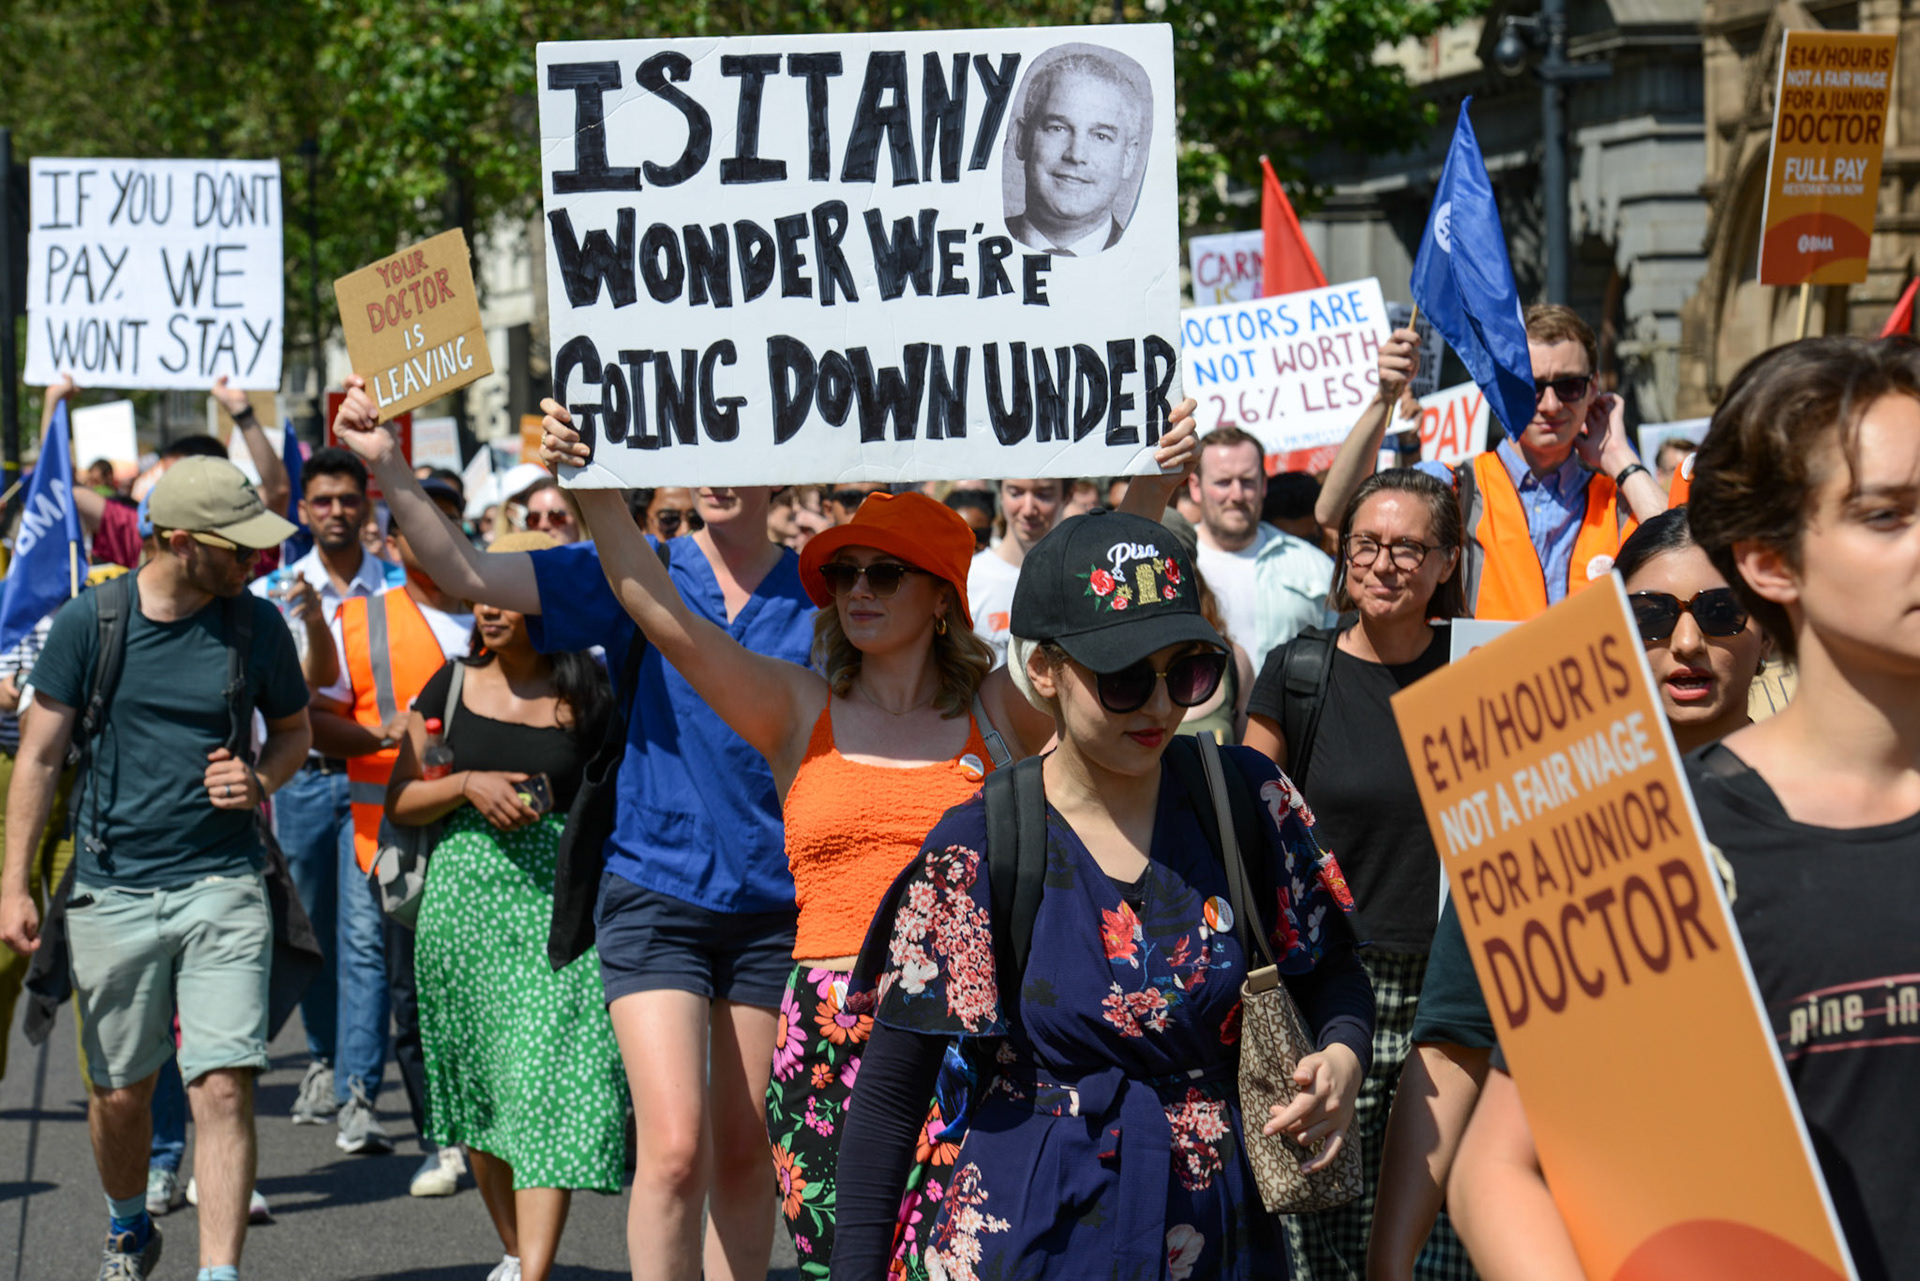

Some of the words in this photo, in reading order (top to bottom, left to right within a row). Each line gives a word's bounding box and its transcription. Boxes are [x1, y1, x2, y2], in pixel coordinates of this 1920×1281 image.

[1785, 69, 1813, 87] NOT
[1812, 71, 1822, 87] A
[1824, 70, 1851, 89] FAIR
[1853, 71, 1888, 90] WAGE
[1790, 45, 1872, 67] £14/HOUR
[1875, 47, 1890, 69] IS
[546, 50, 713, 194] IS
[720, 52, 843, 185] IT
[841, 51, 1021, 187] ANY
[1780, 113, 1882, 145] DOCTOR
[1784, 89, 1814, 110] FOR
[1816, 91, 1827, 109] A
[1829, 91, 1885, 112] JUNIOR
[38, 170, 98, 230] IF
[110, 169, 173, 226] YOU
[194, 171, 278, 229] DONT
[1784, 157, 1830, 181] FULL
[1833, 157, 1868, 182] PAY
[161, 244, 248, 309] WE
[376, 249, 429, 288] YOUR
[548, 199, 859, 309] WONDER
[863, 208, 1052, 307] WE'RE
[366, 268, 456, 334] DOCTOR
[1309, 290, 1370, 331] ARE
[158, 313, 273, 378] STAY
[403, 323, 425, 351] IS
[1193, 349, 1256, 386] NOT
[1272, 329, 1381, 375] WORTH
[373, 335, 473, 408] LEAVING
[554, 335, 746, 467] GOING
[767, 334, 972, 445] DOWN
[983, 334, 1177, 448] UNDER
[1419, 391, 1483, 461] PAY
[1421, 657, 1595, 793] £14/HOUR
[1587, 634, 1631, 706] IS
[1438, 783, 1499, 856] NOT
[1498, 784, 1520, 832] A
[1512, 751, 1579, 823] FAIR
[1581, 711, 1657, 793] WAGE
[1460, 849, 1530, 927] FOR
[1530, 838, 1559, 897] A
[1552, 781, 1682, 896] JUNIOR
[1482, 858, 1719, 1030] DOCTOR
